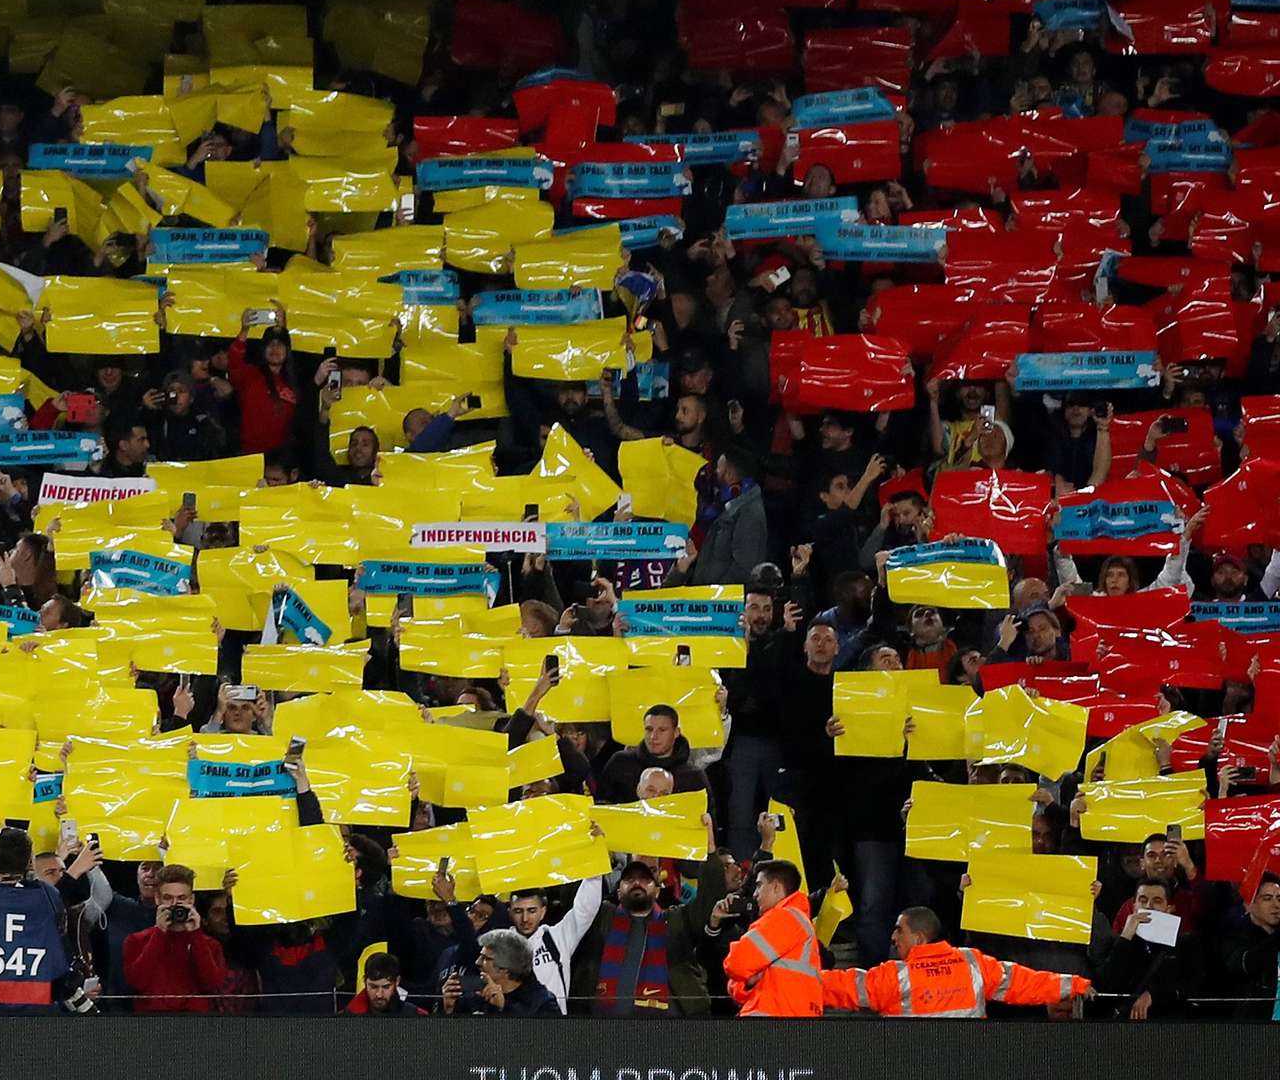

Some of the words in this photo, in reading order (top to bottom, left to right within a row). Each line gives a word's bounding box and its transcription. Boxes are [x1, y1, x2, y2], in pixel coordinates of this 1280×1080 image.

[613, 526, 633, 536] AND
[637, 526, 663, 536] TALK!
[129, 557, 149, 568] AND
[380, 565, 411, 575] SPAIN,
[416, 566, 430, 575] SIT
[435, 566, 454, 575] AND
[635, 604, 666, 613] SPAIN,
[671, 604, 684, 612] SIT
[689, 604, 708, 612] AND
[712, 604, 739, 613] TALK!
[1191, 604, 1221, 615] SPAIN,
[1226, 605, 1239, 614] SIT
[1244, 605, 1264, 614] AND
[16, 611, 38, 622] TALK
[201, 765, 232, 777] SPAIN,
[237, 767, 250, 777] SIT
[255, 765, 275, 776] AND
[5, 913, 26, 942] F
